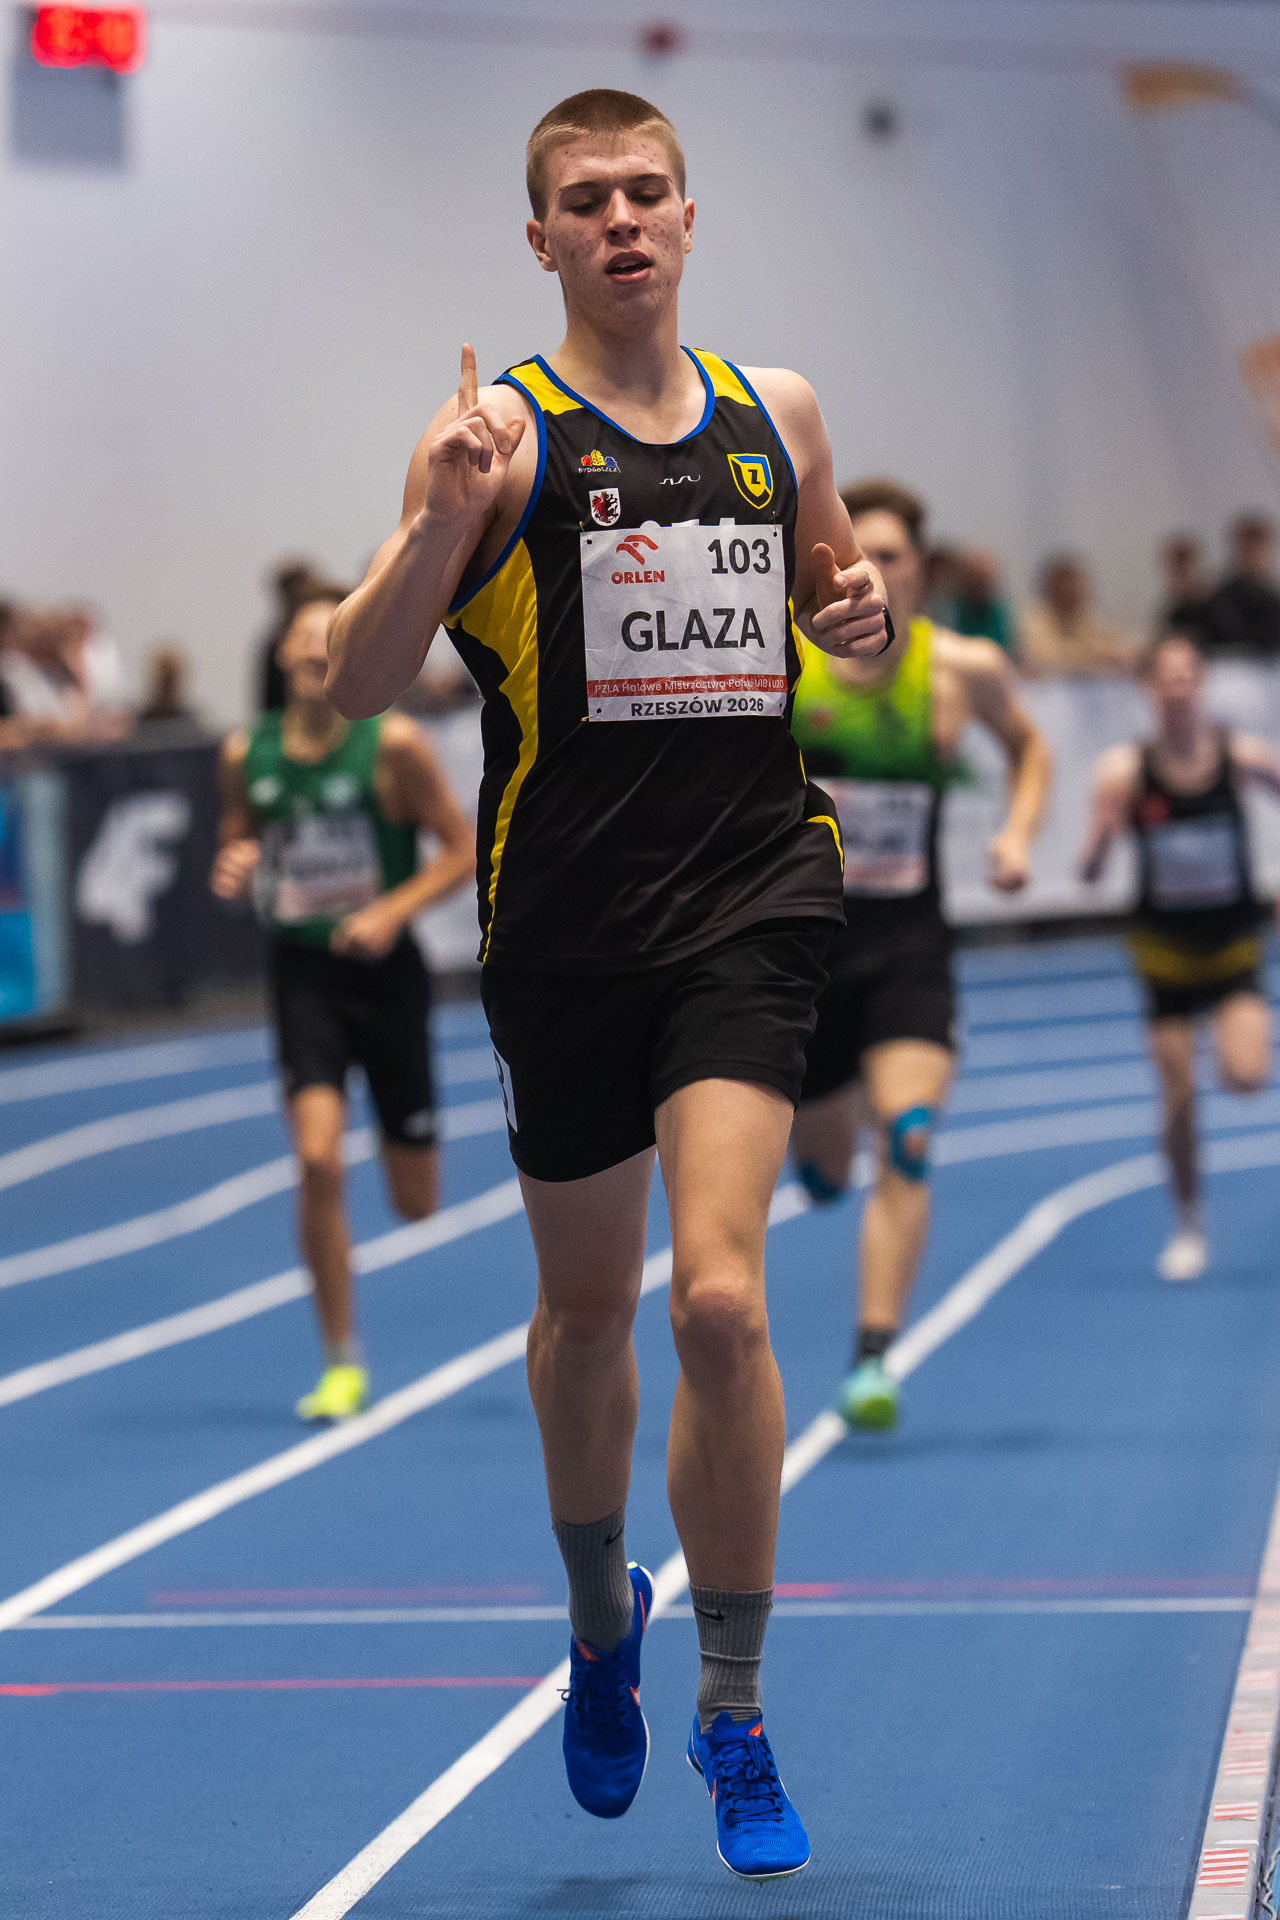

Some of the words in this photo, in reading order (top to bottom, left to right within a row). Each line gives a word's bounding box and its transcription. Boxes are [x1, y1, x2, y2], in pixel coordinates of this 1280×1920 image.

[747, 469, 761, 484] Z
[708, 538, 771, 574] 103
[611, 570, 665, 584] ORLEN
[621, 608, 765, 652] GLAZA
[595, 684, 619, 694] PZLA
[622, 682, 662, 692] Halowe
[664, 680, 726, 691] Mistrzostwa
[755, 678, 767, 688] U18
[772, 679, 784, 689] U20
[631, 696, 722, 717] RZESZÓW
[727, 698, 764, 712] 2026
